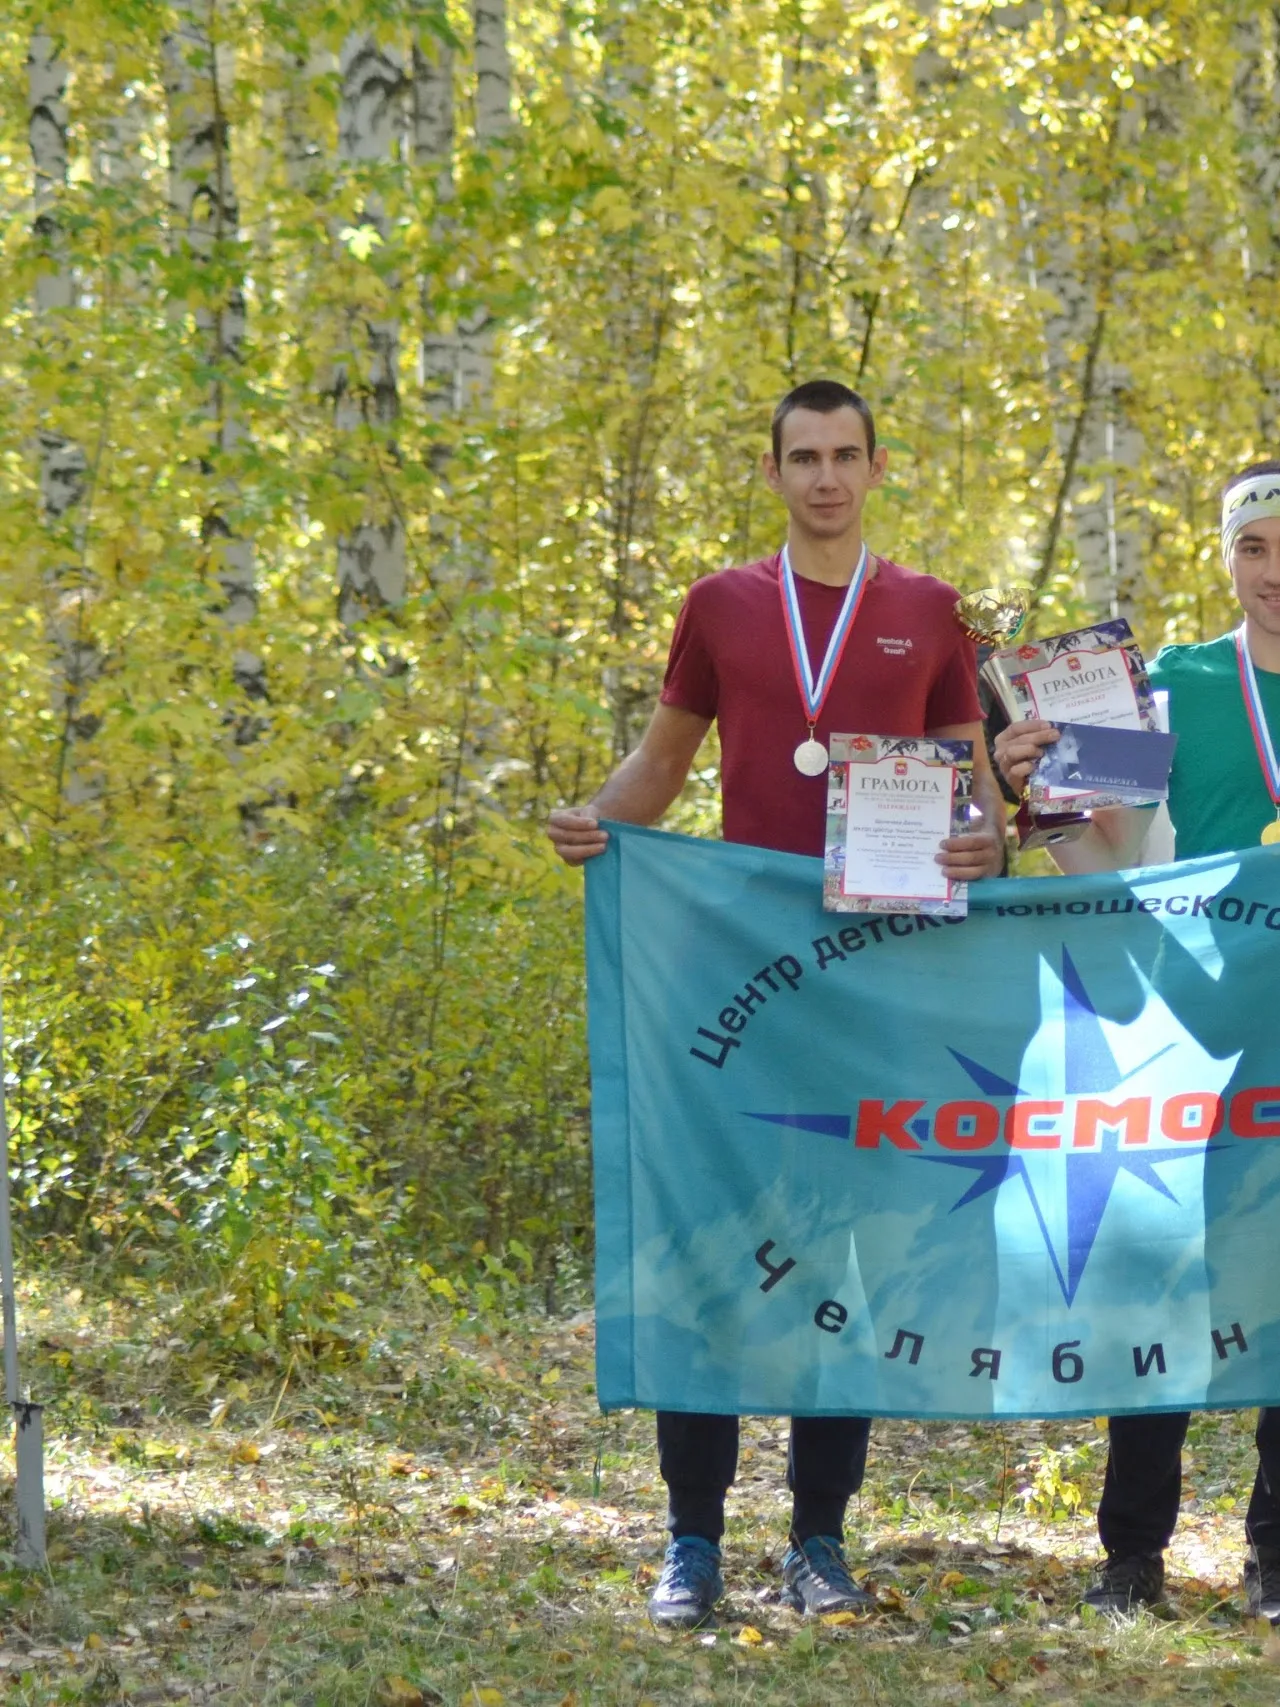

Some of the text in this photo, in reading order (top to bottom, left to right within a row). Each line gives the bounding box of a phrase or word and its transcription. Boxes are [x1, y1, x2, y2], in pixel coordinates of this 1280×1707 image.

[1042, 666, 1117, 695] ГРАМОТА
[861, 777, 940, 793] ГРАМОТА
[690, 954, 803, 1069] Центр
